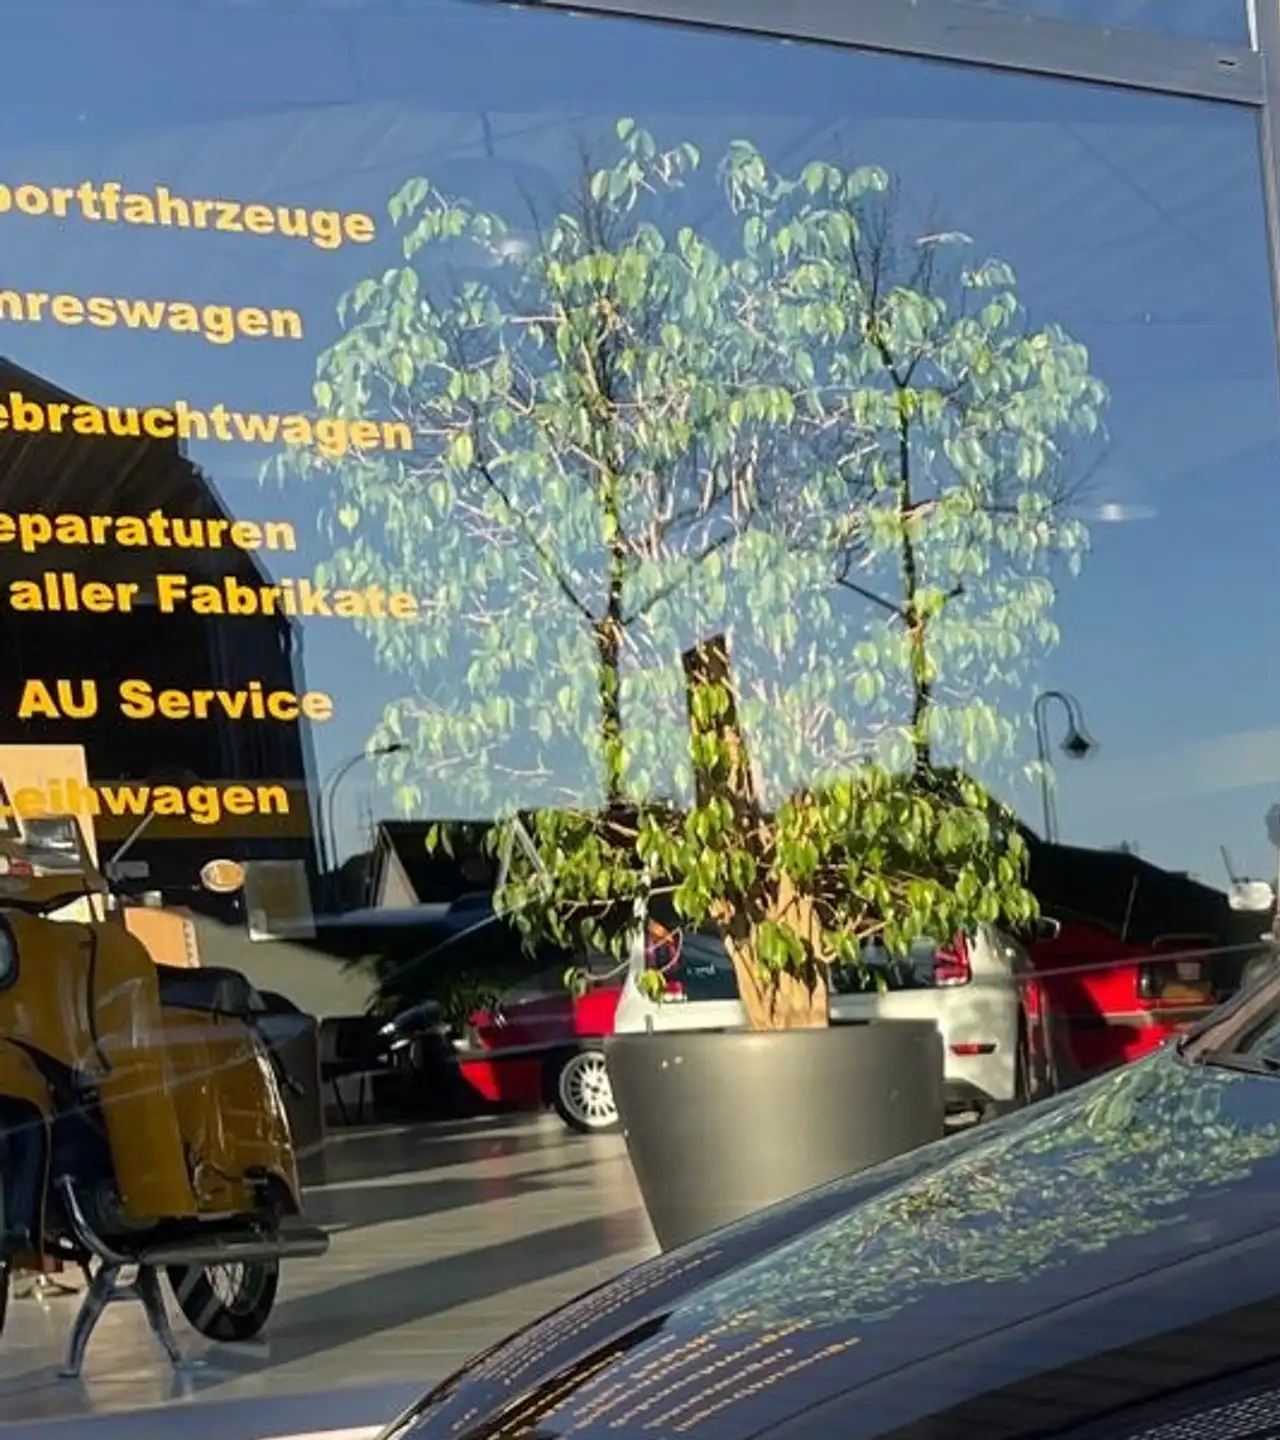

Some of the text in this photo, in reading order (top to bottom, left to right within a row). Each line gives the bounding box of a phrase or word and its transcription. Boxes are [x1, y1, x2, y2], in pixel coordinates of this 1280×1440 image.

[0, 391, 413, 457] brauchtwagen
[9, 572, 420, 622] aller Fabrikate
[18, 678, 334, 722] AU Service
